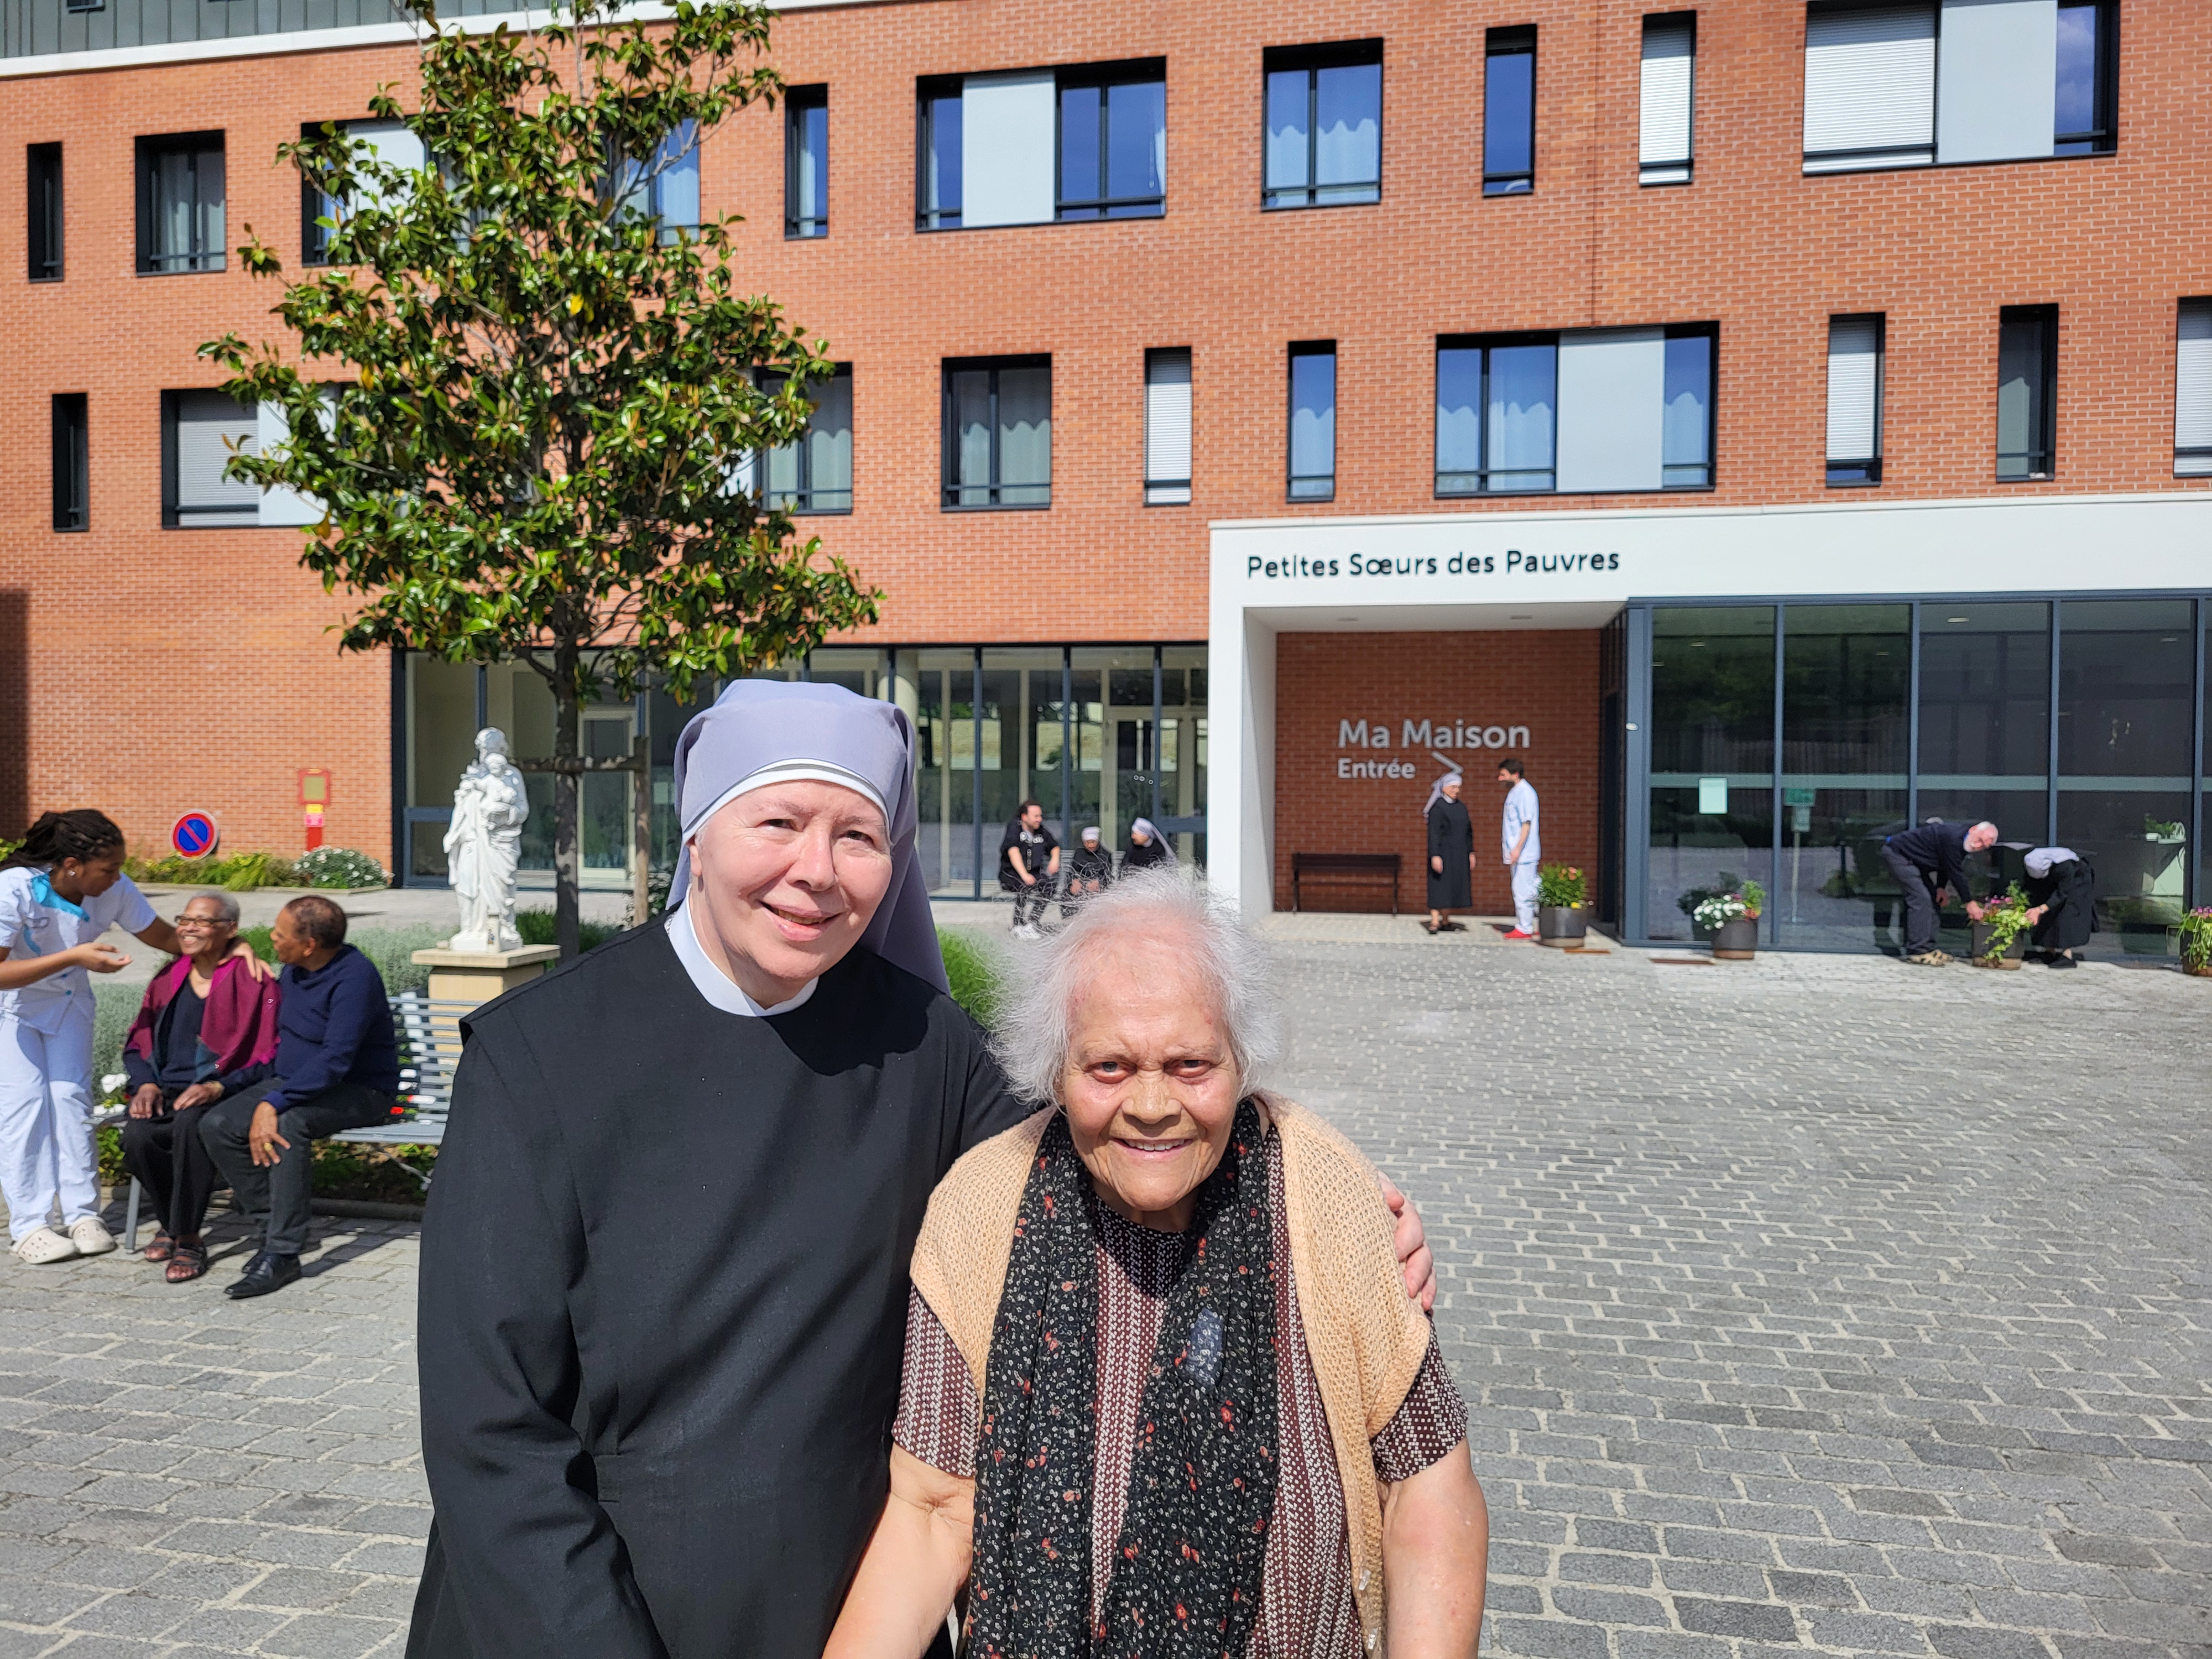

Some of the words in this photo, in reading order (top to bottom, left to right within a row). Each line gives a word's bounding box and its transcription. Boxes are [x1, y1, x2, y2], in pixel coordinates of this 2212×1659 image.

[1247, 554, 1339, 578] Petites
[1349, 553, 1438, 576] Sœurs
[1447, 551, 1495, 575] des
[1506, 550, 1620, 573] Pauvres
[1338, 718, 1390, 749] Ma
[1401, 718, 1531, 749] Maison
[1337, 757, 1416, 780] Entrée
